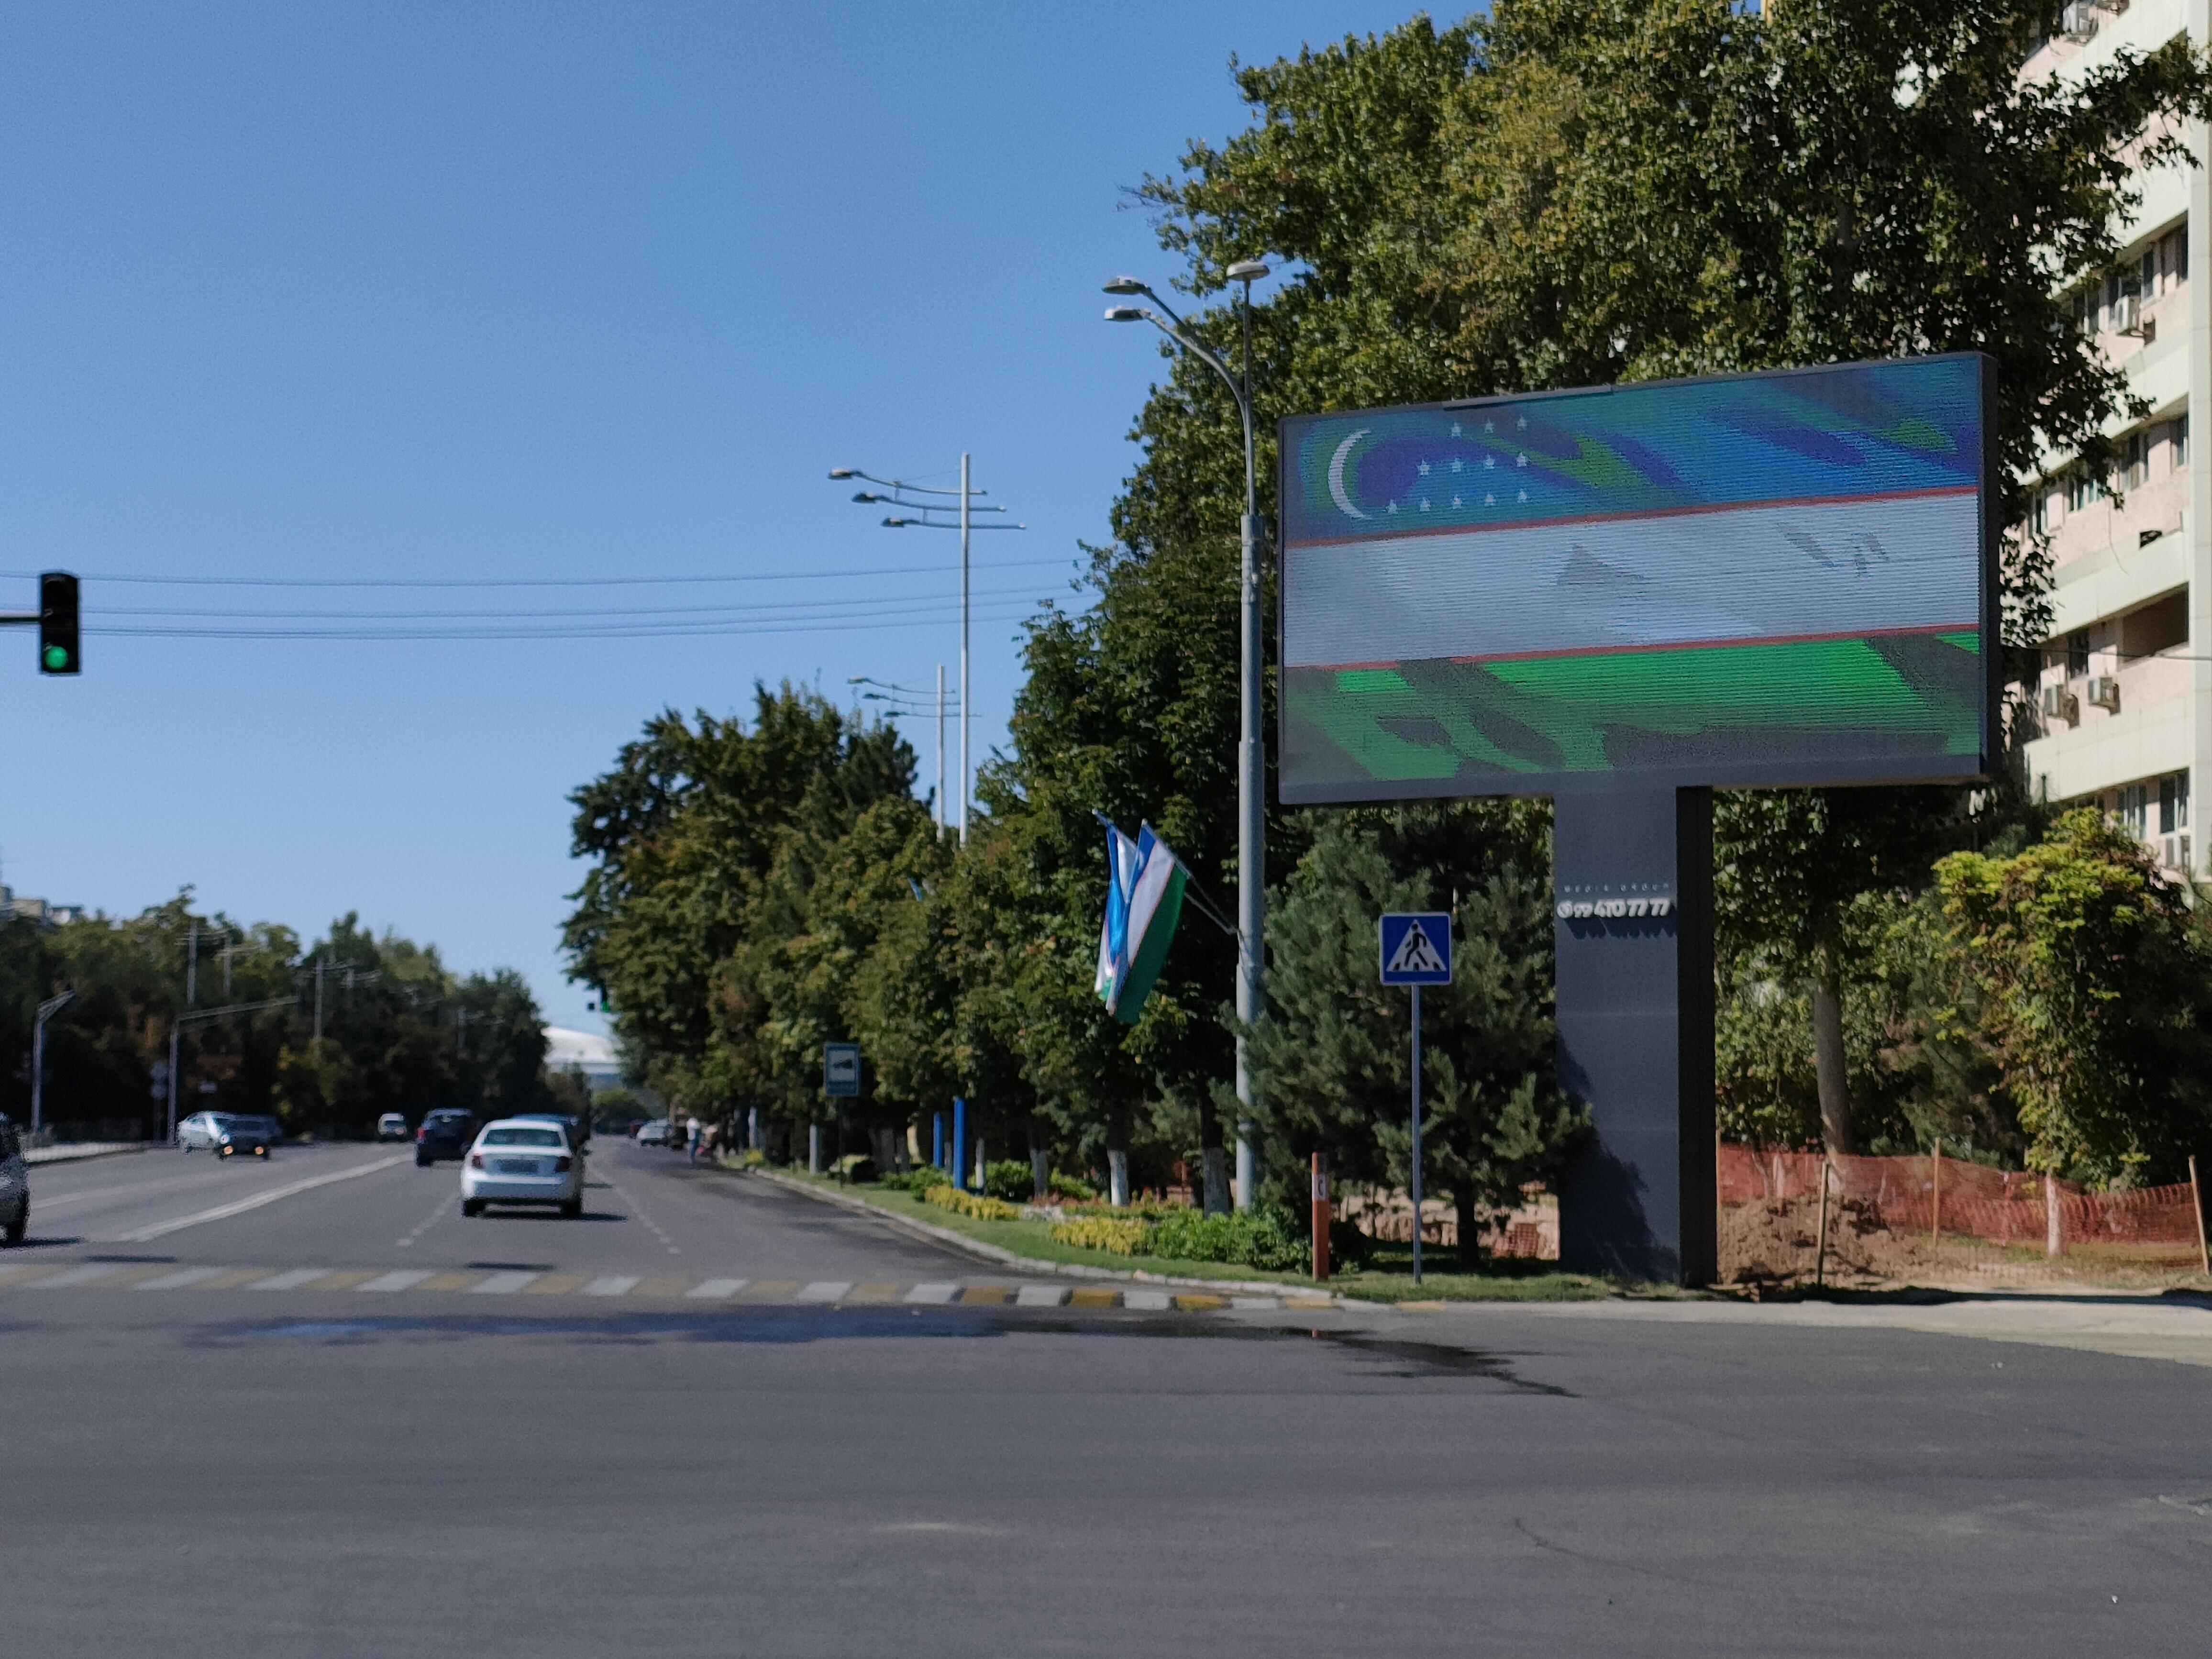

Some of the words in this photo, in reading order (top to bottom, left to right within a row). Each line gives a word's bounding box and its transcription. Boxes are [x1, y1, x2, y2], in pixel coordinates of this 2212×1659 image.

[1594, 898, 1626, 918] 410
[1626, 897, 1648, 917] 77
[1649, 897, 1670, 917] 77
